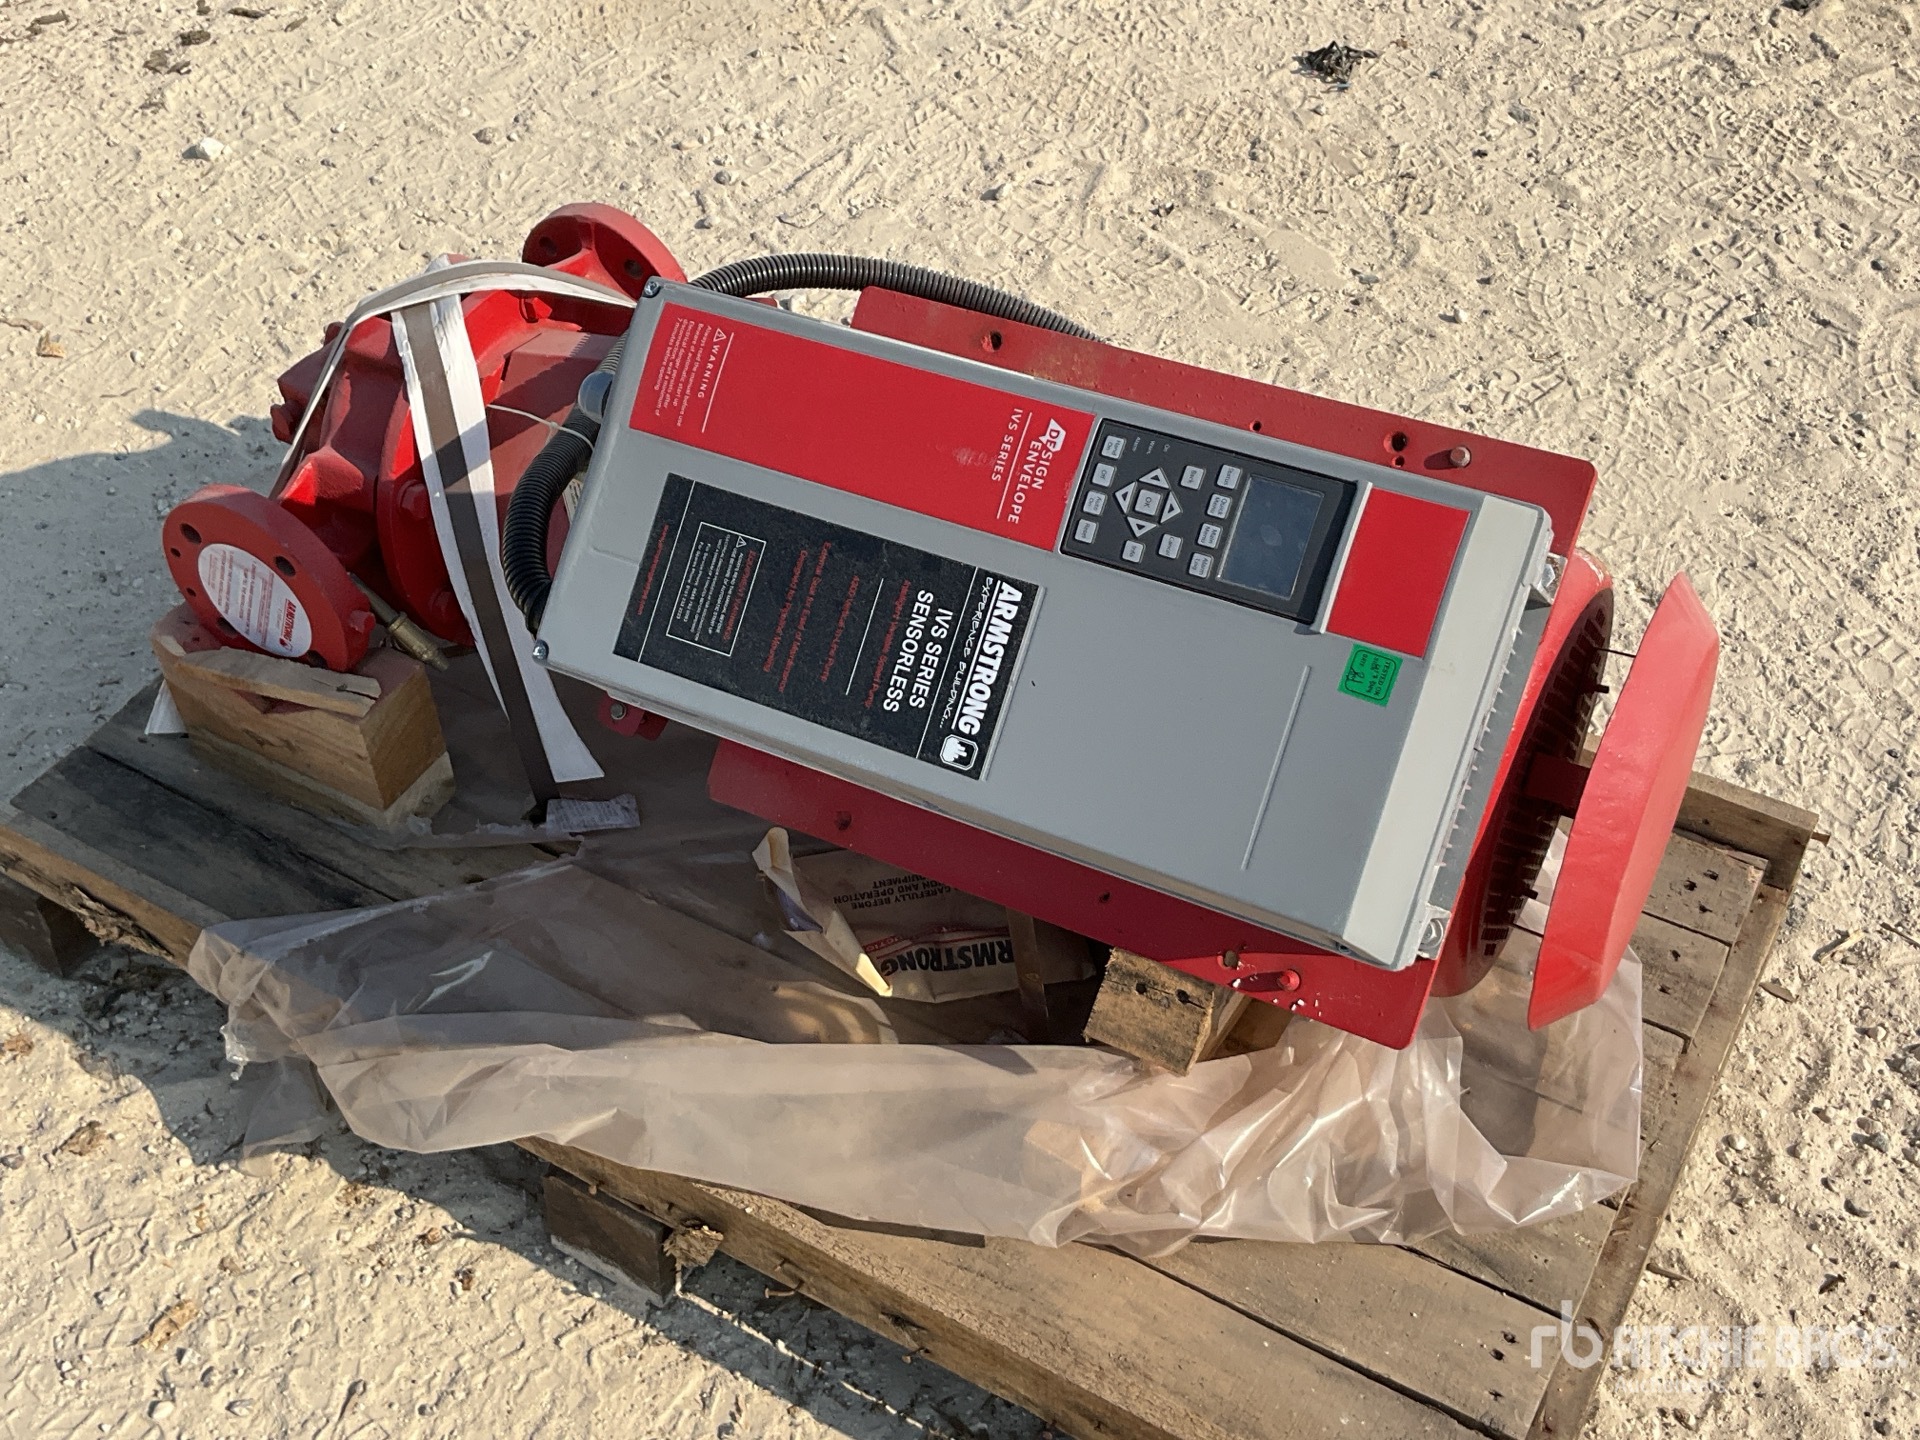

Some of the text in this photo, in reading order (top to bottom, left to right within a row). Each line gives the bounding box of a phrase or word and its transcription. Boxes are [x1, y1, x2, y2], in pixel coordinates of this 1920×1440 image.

[668, 321, 679, 345] minutes
[681, 320, 695, 348] Electrical
[700, 325, 712, 346] Always
[661, 346, 672, 365] before
[672, 322, 704, 406] Beware of automatic start up
[674, 347, 685, 369] danger
[695, 347, 703, 361] read
[691, 361, 699, 372] the
[697, 344, 719, 397] WARNING
[653, 365, 665, 390] opening
[667, 368, 677, 392] persists
[685, 371, 695, 395] manual
[679, 394, 689, 414] before
[991, 408, 1023, 480] IVS SERIES
[1105, 441, 1113, 450] On
[1111, 439, 1121, 456] Hand
[1033, 428, 1060, 489] DESIGN
[1008, 441, 1037, 523] ENVELOPE
[1099, 468, 1107, 479] Off
[1187, 469, 1197, 483] Back
[1223, 467, 1234, 485] Status
[1087, 496, 1094, 507] On
[1092, 495, 1102, 511] Auto
[1143, 496, 1152, 508] OK
[1209, 496, 1220, 513] Menu
[1217, 497, 1227, 515] Quick
[1081, 522, 1090, 538] Reset
[1200, 526, 1210, 543] Menu
[1208, 529, 1217, 544] Main
[1128, 545, 1136, 557] Info
[1165, 536, 1174, 556] Cancel
[1191, 557, 1200, 570] Log
[1198, 557, 1208, 575] Alarm
[283, 600, 296, 641] ARMSTRONG
[963, 576, 993, 657] EXPERIENCE
[883, 590, 933, 711] SENSORLESS
[909, 608, 953, 707] IVS SERIES
[959, 582, 1022, 735] ARMSTRONG
[1377, 660, 1390, 685] TESTED
[833, 880, 941, 904] ON AND OPERATION
[850, 886, 951, 909] CAREFULLY BEFORE
[881, 940, 1014, 977] RMSTRONG
